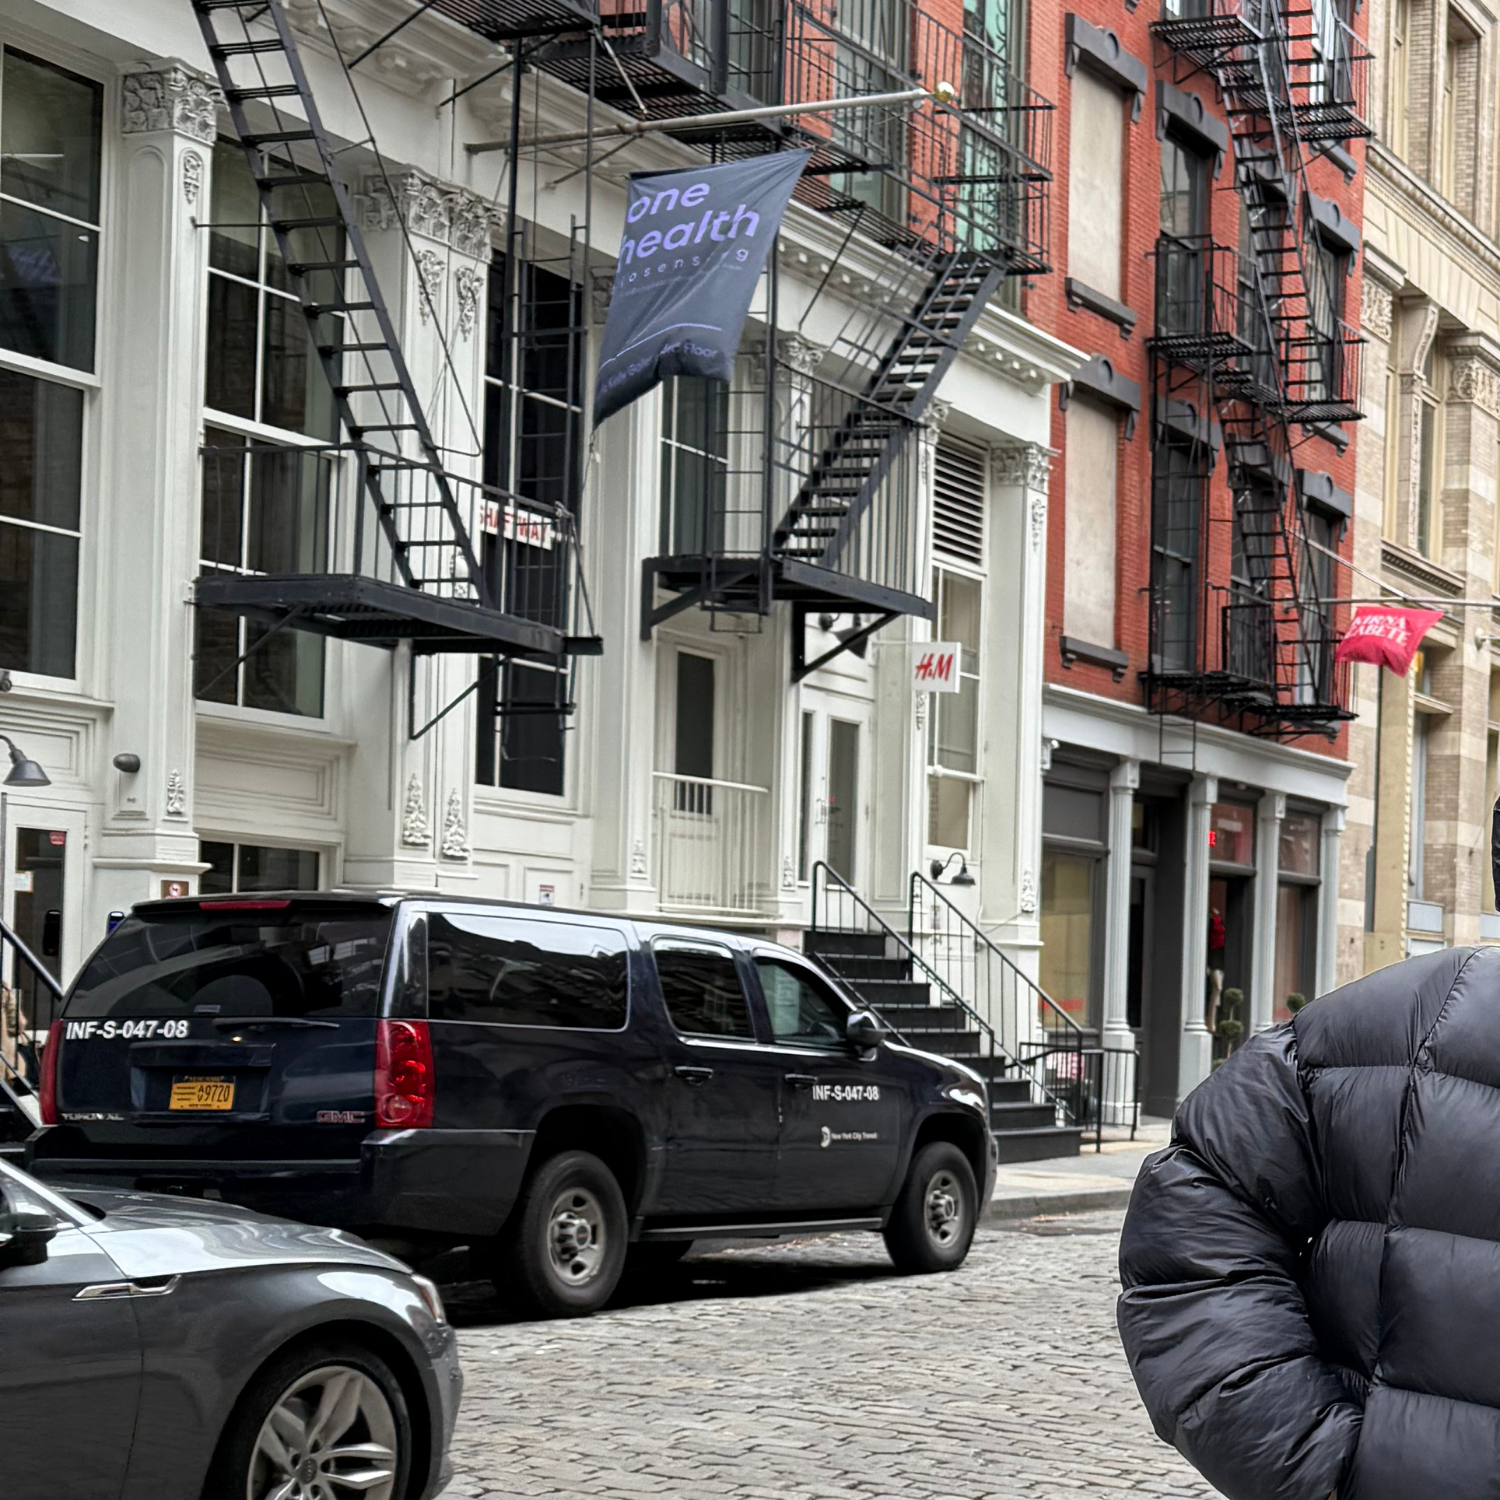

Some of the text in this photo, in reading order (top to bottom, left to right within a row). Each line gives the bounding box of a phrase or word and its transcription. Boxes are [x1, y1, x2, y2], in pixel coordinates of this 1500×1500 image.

[627, 183, 710, 224] one
[617, 204, 760, 273] health
[915, 653, 953, 681] H&M
[66, 1020, 188, 1039] INF-S-047-08
[812, 1085, 879, 1101] INF-S-047-08
[316, 1110, 365, 1124] GMC
